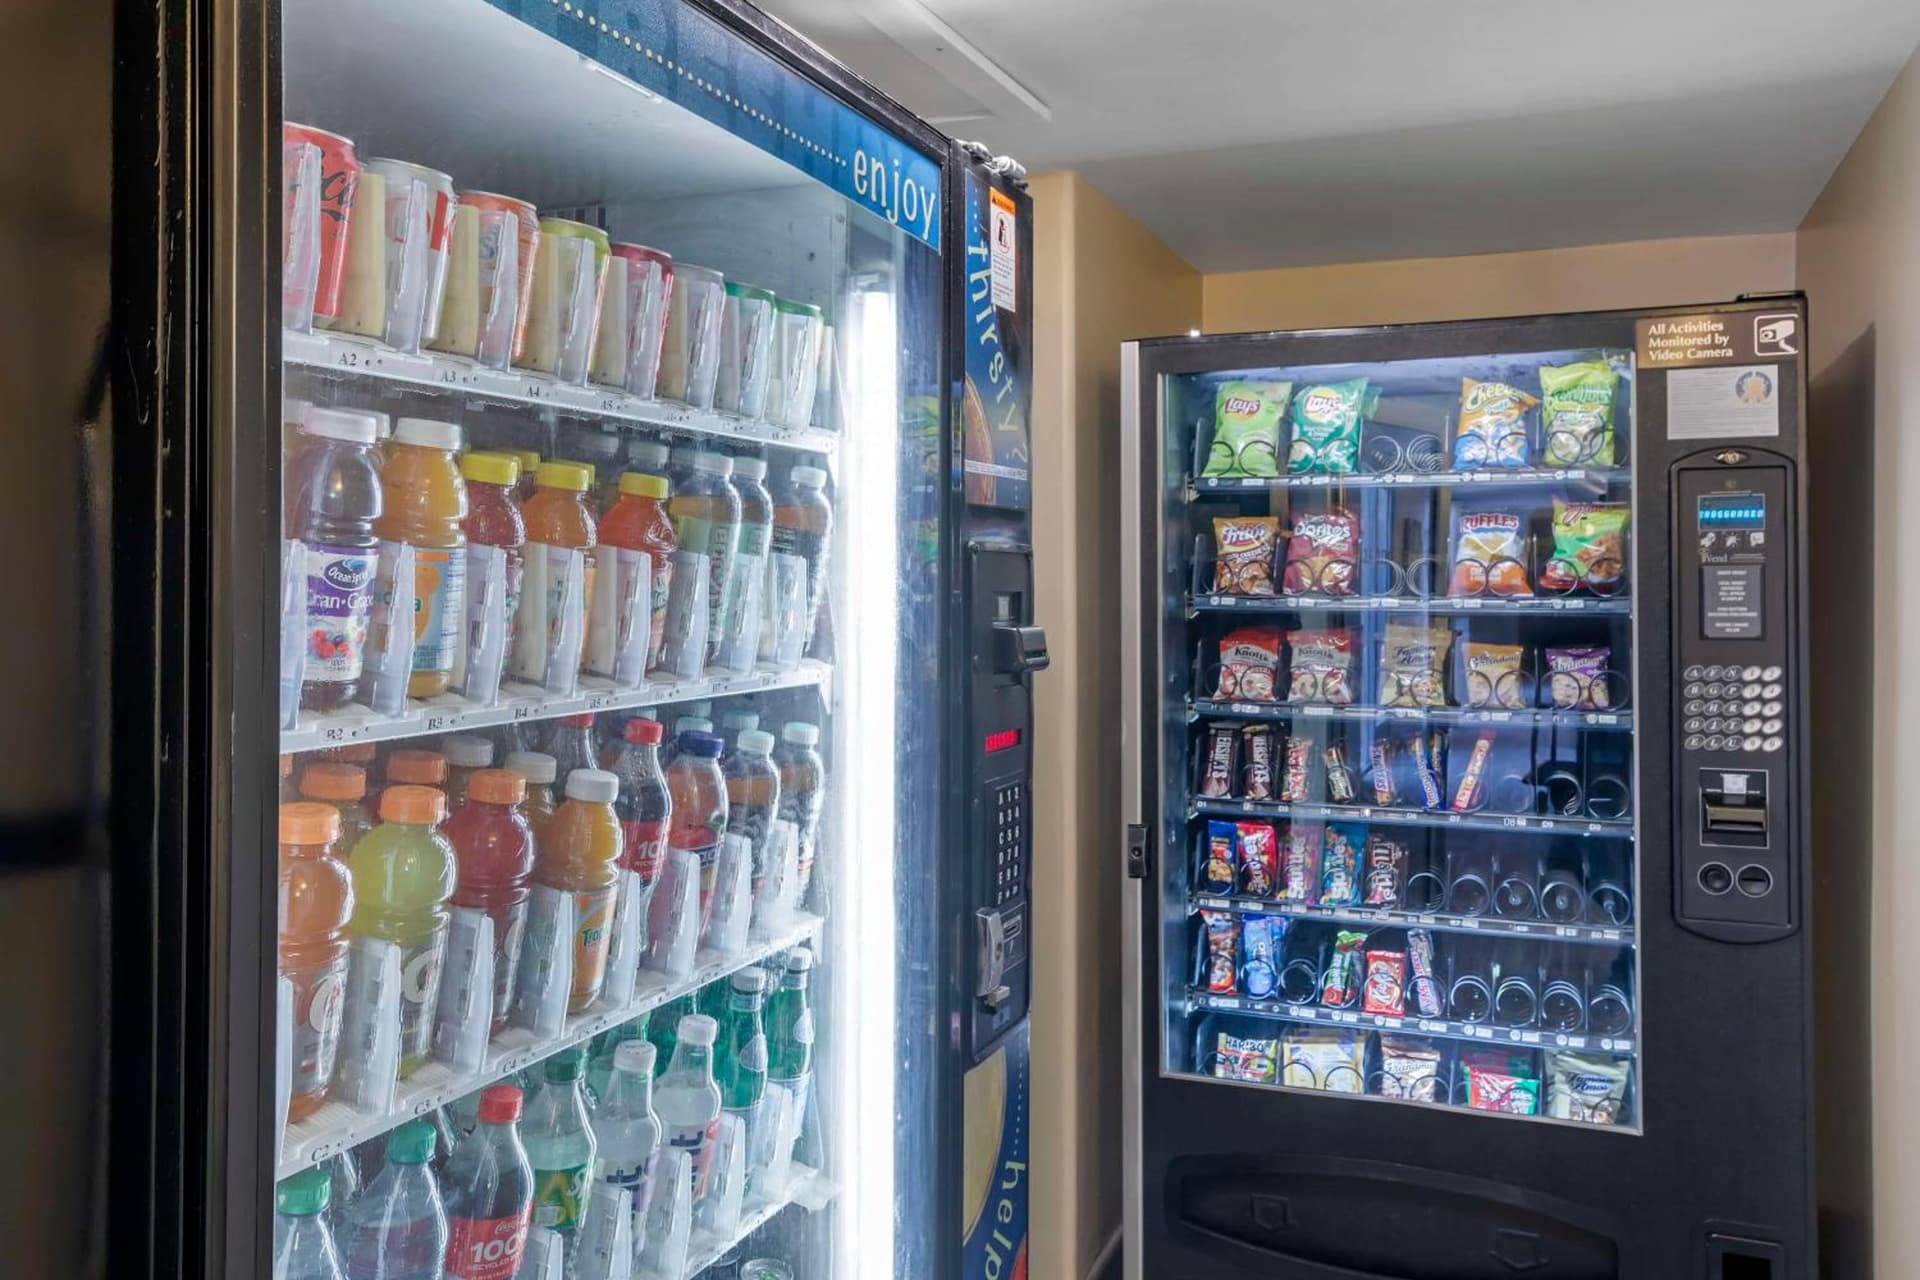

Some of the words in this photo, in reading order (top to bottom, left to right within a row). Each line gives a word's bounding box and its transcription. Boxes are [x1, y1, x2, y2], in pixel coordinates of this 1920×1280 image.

[853, 148, 936, 241] enjoy
[1648, 324, 1666, 335] All
[1666, 320, 1724, 334] Activities
[1648, 334, 1713, 348] Monitored
[1714, 333, 1729, 347] by
[338, 353, 357, 366] A2
[1649, 350, 1684, 361] Video
[1686, 348, 1733, 360] Camera
[441, 370, 456, 382] A3
[1294, 520, 1351, 537] Doritos
[1461, 513, 1519, 531] RUFFLES
[328, 566, 352, 583] Ocean
[311, 1145, 330, 1162] C2
